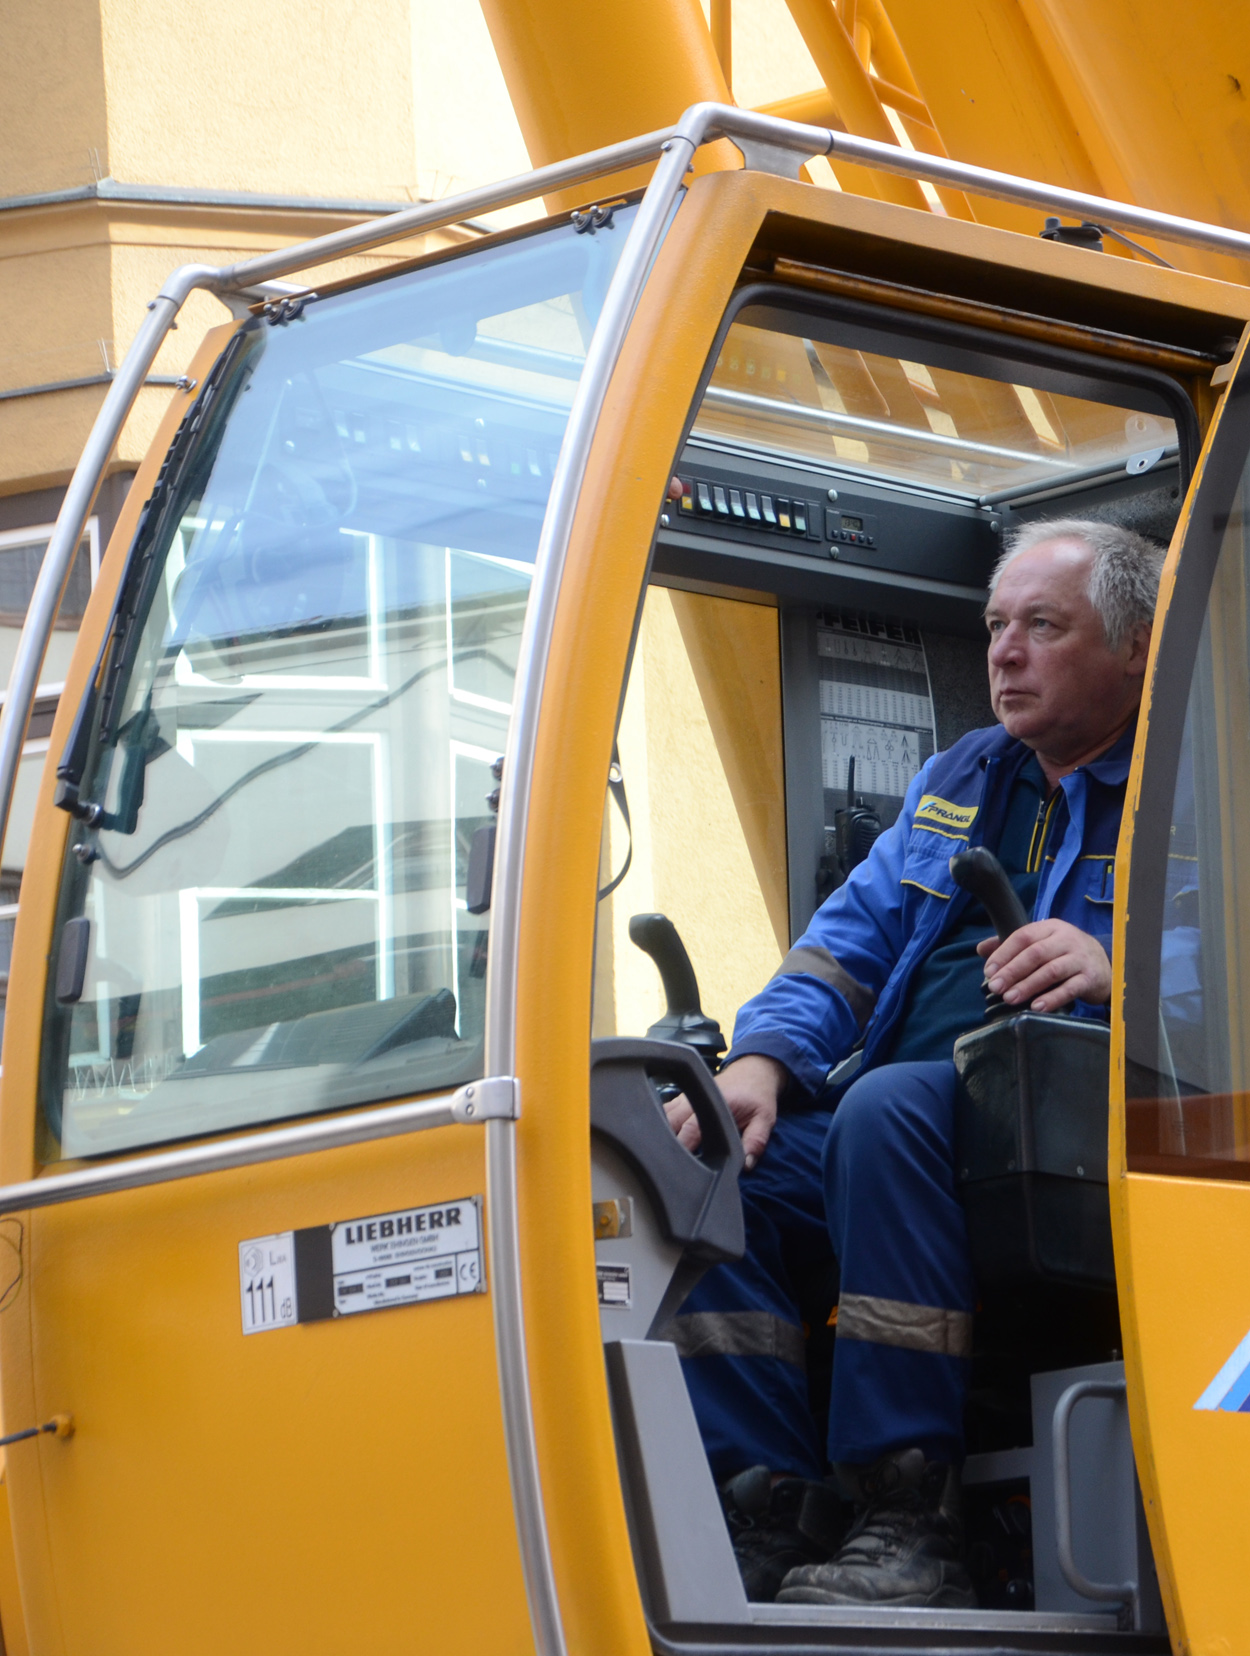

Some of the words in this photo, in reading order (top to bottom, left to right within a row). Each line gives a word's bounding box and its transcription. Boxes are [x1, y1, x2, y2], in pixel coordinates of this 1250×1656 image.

[928, 804, 971, 823] PRANGL
[345, 1207, 461, 1246] LIEBHERR
[246, 1275, 276, 1325] 111
[280, 1297, 293, 1319] dB
